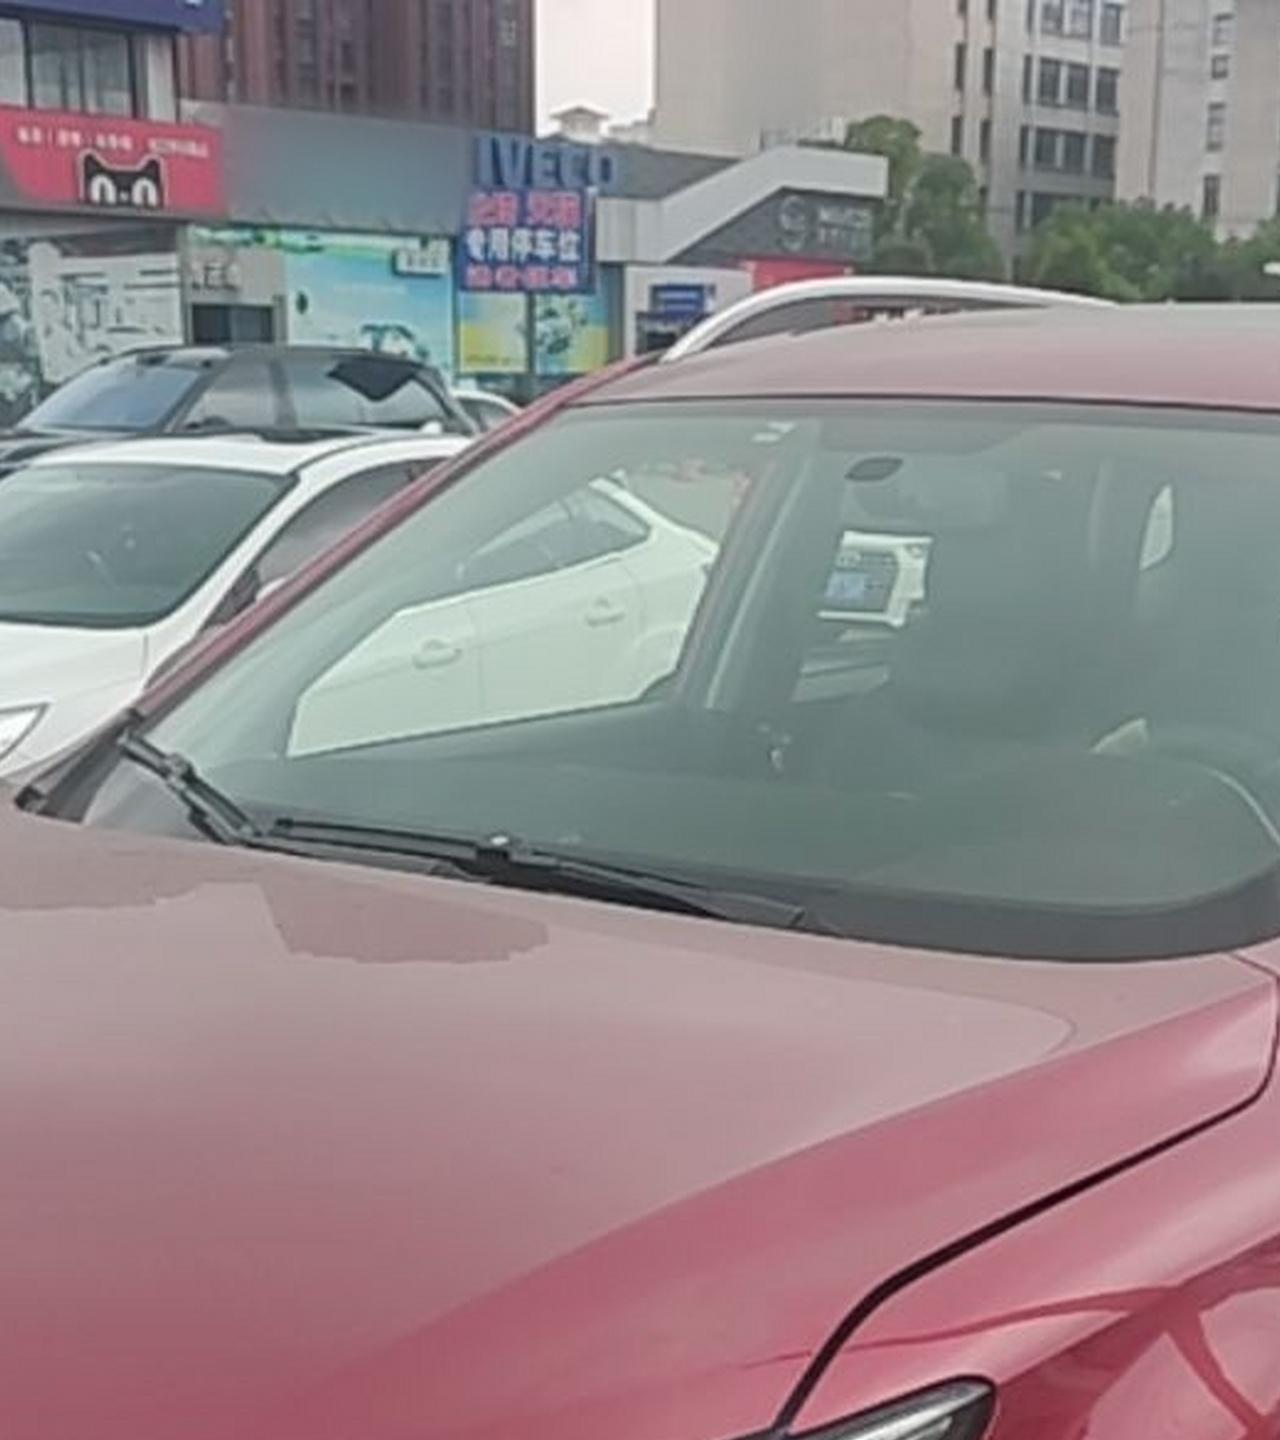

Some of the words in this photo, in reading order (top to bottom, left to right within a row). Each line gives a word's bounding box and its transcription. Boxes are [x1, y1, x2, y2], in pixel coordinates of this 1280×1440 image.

[476, 134, 618, 191] IVECO
[467, 228, 580, 263] 专用停车位
